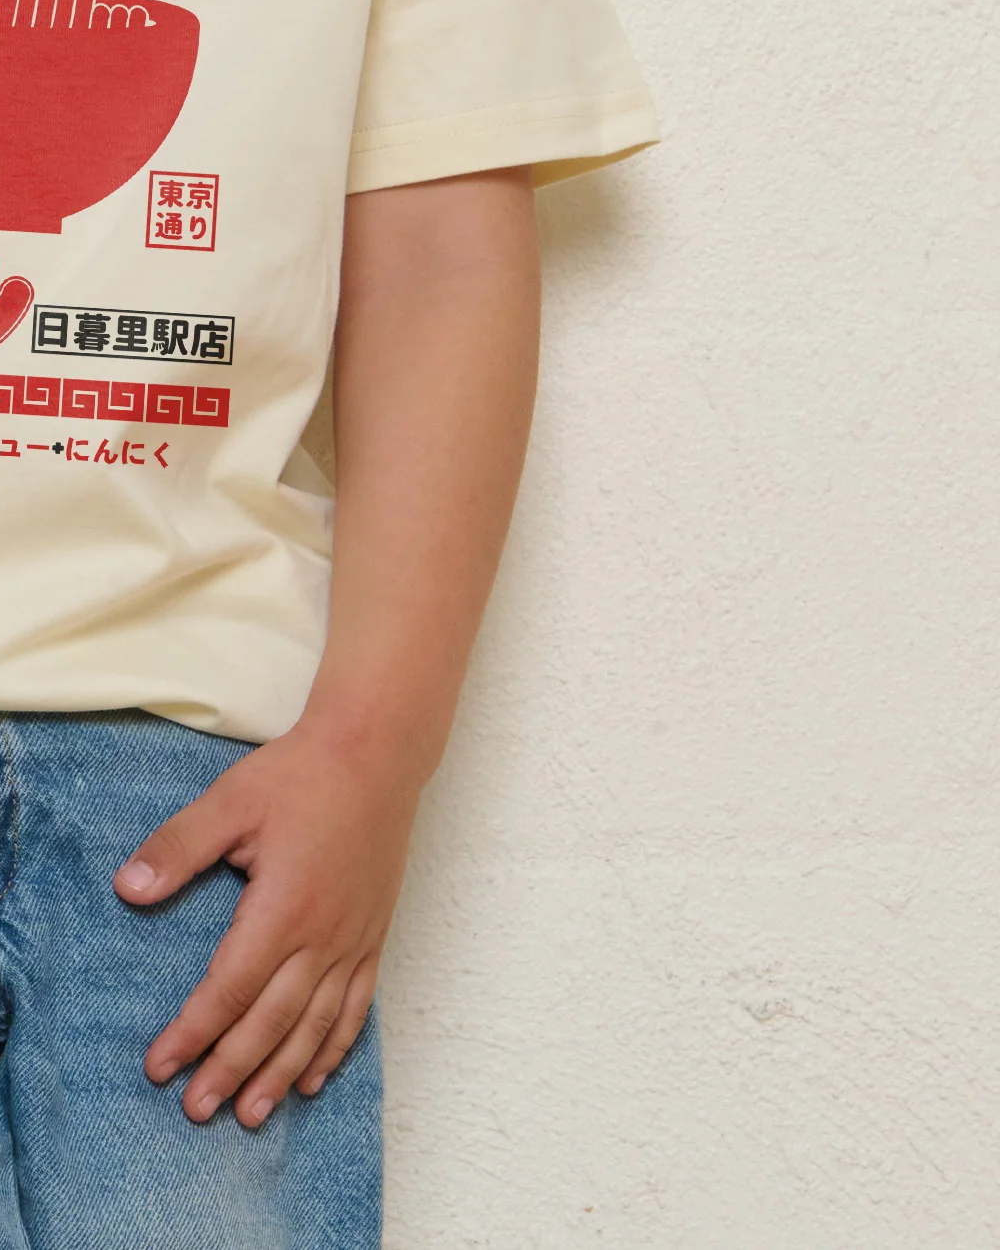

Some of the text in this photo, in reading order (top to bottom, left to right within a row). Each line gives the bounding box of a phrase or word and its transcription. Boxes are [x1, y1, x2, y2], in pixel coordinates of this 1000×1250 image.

[157, 179, 214, 210] 東京
[154, 211, 207, 241] 通り
[37, 311, 229, 360] 日暮里駅店
